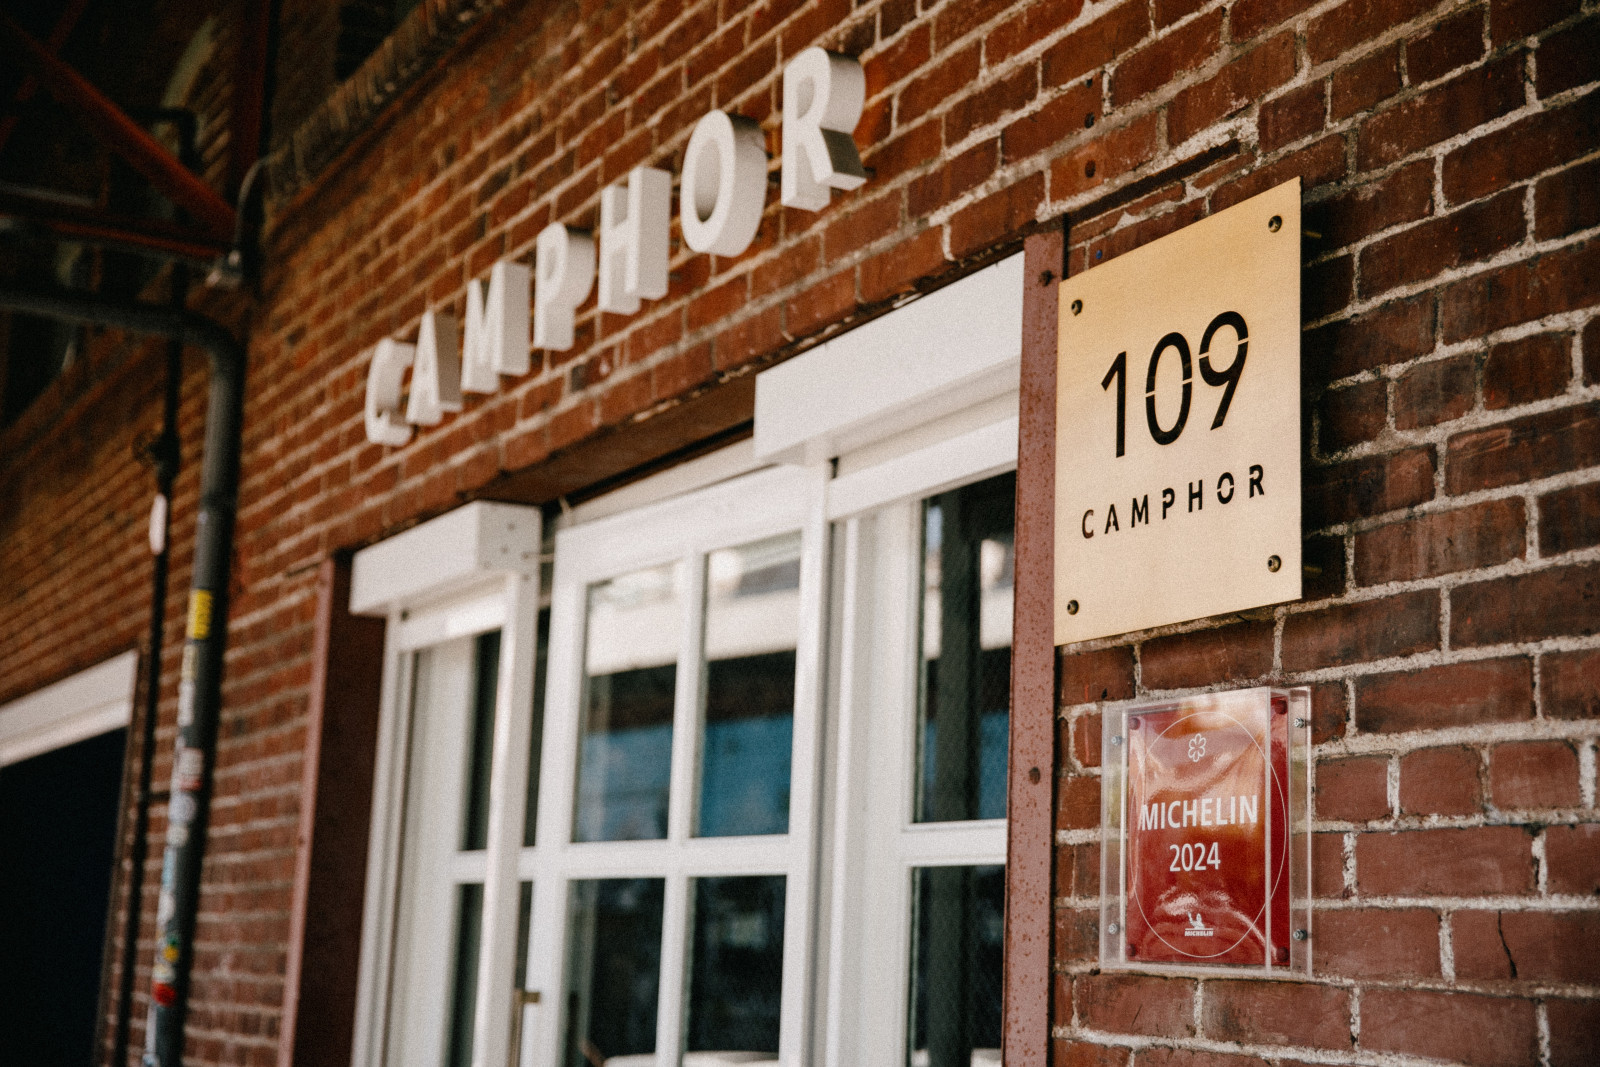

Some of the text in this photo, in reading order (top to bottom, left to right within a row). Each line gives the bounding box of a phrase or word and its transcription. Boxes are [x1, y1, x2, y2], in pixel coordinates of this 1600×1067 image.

[365, 46, 866, 446] CAMPHOR
[1101, 311, 1249, 458] 109
[1081, 464, 1264, 539] CAMPHOR
[1138, 795, 1257, 831] MICHELIN
[1169, 842, 1221, 872] 2024
